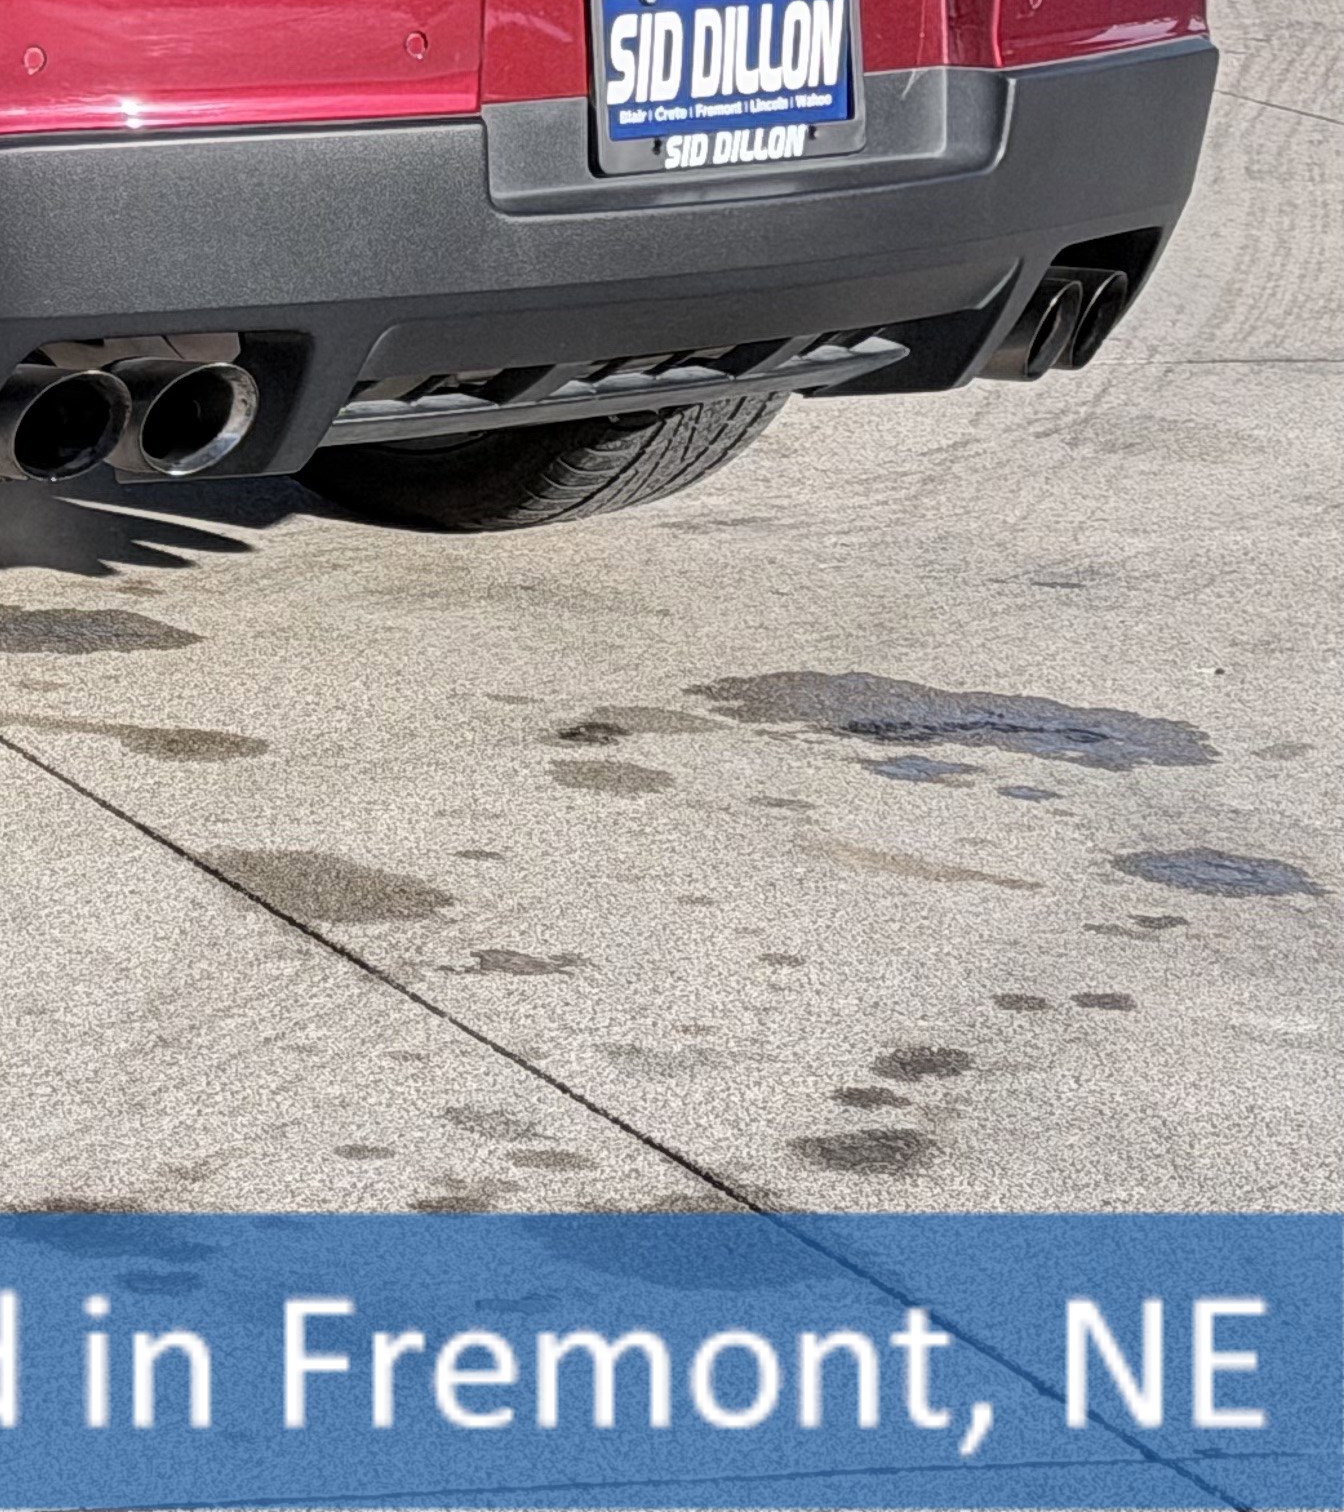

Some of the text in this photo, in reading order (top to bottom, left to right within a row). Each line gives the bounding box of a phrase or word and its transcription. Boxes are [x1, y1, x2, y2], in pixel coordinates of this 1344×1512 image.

[606, 11, 683, 105] SID
[695, 100, 743, 118] Fremont
[664, 123, 808, 170] SID DILLON
